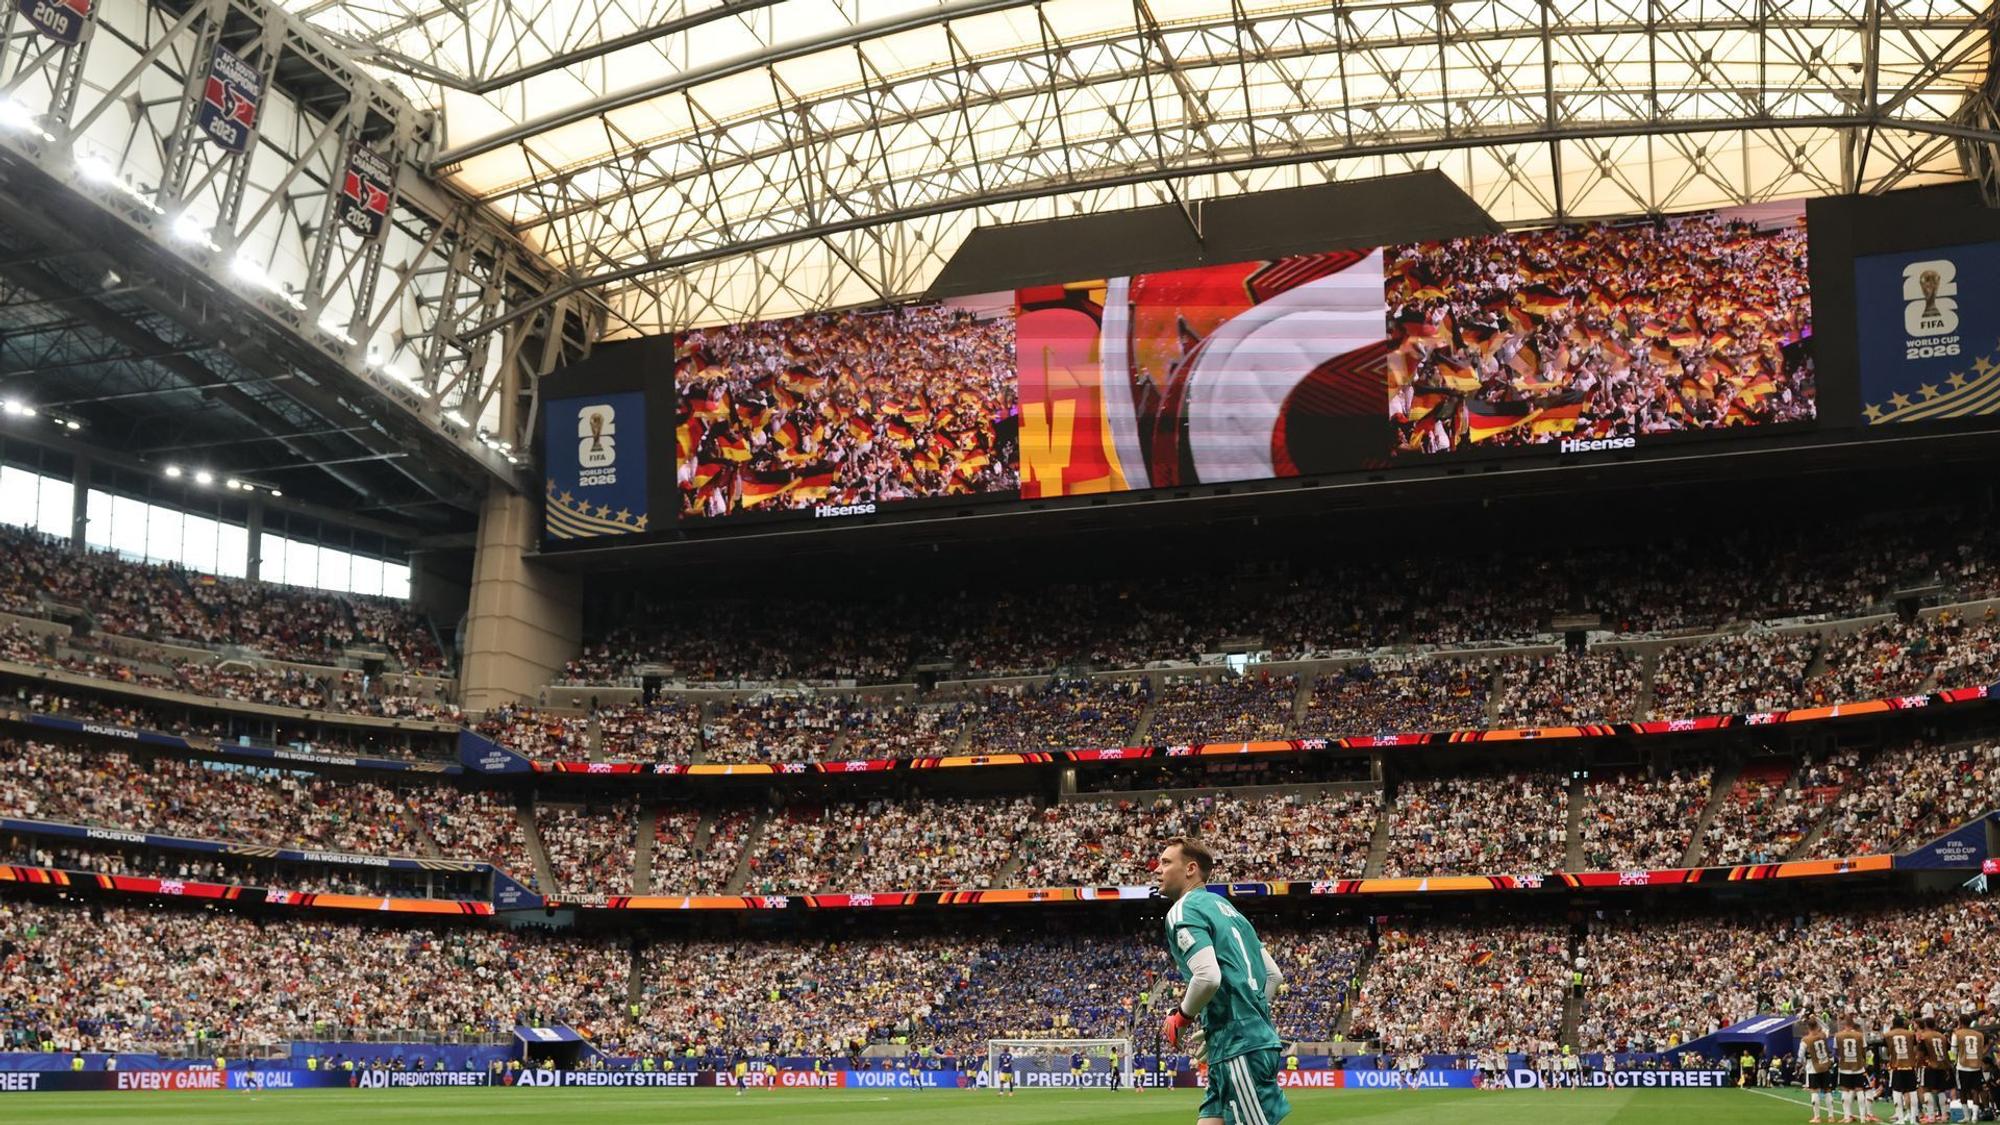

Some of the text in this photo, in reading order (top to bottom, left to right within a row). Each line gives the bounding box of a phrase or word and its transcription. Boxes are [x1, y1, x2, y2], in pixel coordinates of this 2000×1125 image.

[33, 1, 69, 35] 2019
[214, 57, 259, 97] CHAMPIONS
[209, 116, 238, 145] 2023
[351, 153, 391, 186] CHAMPIONS
[346, 206, 372, 233] 2024
[1920, 319, 1945, 330] FIFA
[1906, 335, 1960, 348] WORLD CUP
[1906, 344, 1961, 360] 2026
[1560, 437, 1636, 453] Hisense
[589, 453, 607, 462] FIFA
[579, 467, 616, 477] WORLD CUP
[579, 474, 617, 487] 2026
[815, 503, 876, 518] Hisense
[82, 723, 138, 739] HOUSTON
[273, 750, 290, 759] FIFA
[290, 752, 315, 761] WORLD
[86, 829, 146, 843] HOUSTON
[304, 853, 320, 862] FIFA
[321, 854, 348, 863] WORLD
[1231, 926, 1259, 991] 1
[117, 1071, 221, 1089] EVERY GAME
[266, 1071, 293, 1087] CALL
[359, 1070, 485, 1088] ADI PREDICTSTREET
[516, 1069, 698, 1087] ADI PREDICTSTREET
[856, 1072, 896, 1087] YOUR
[1276, 1071, 1335, 1087] GAME
[1356, 1071, 1401, 1087] YOUR
